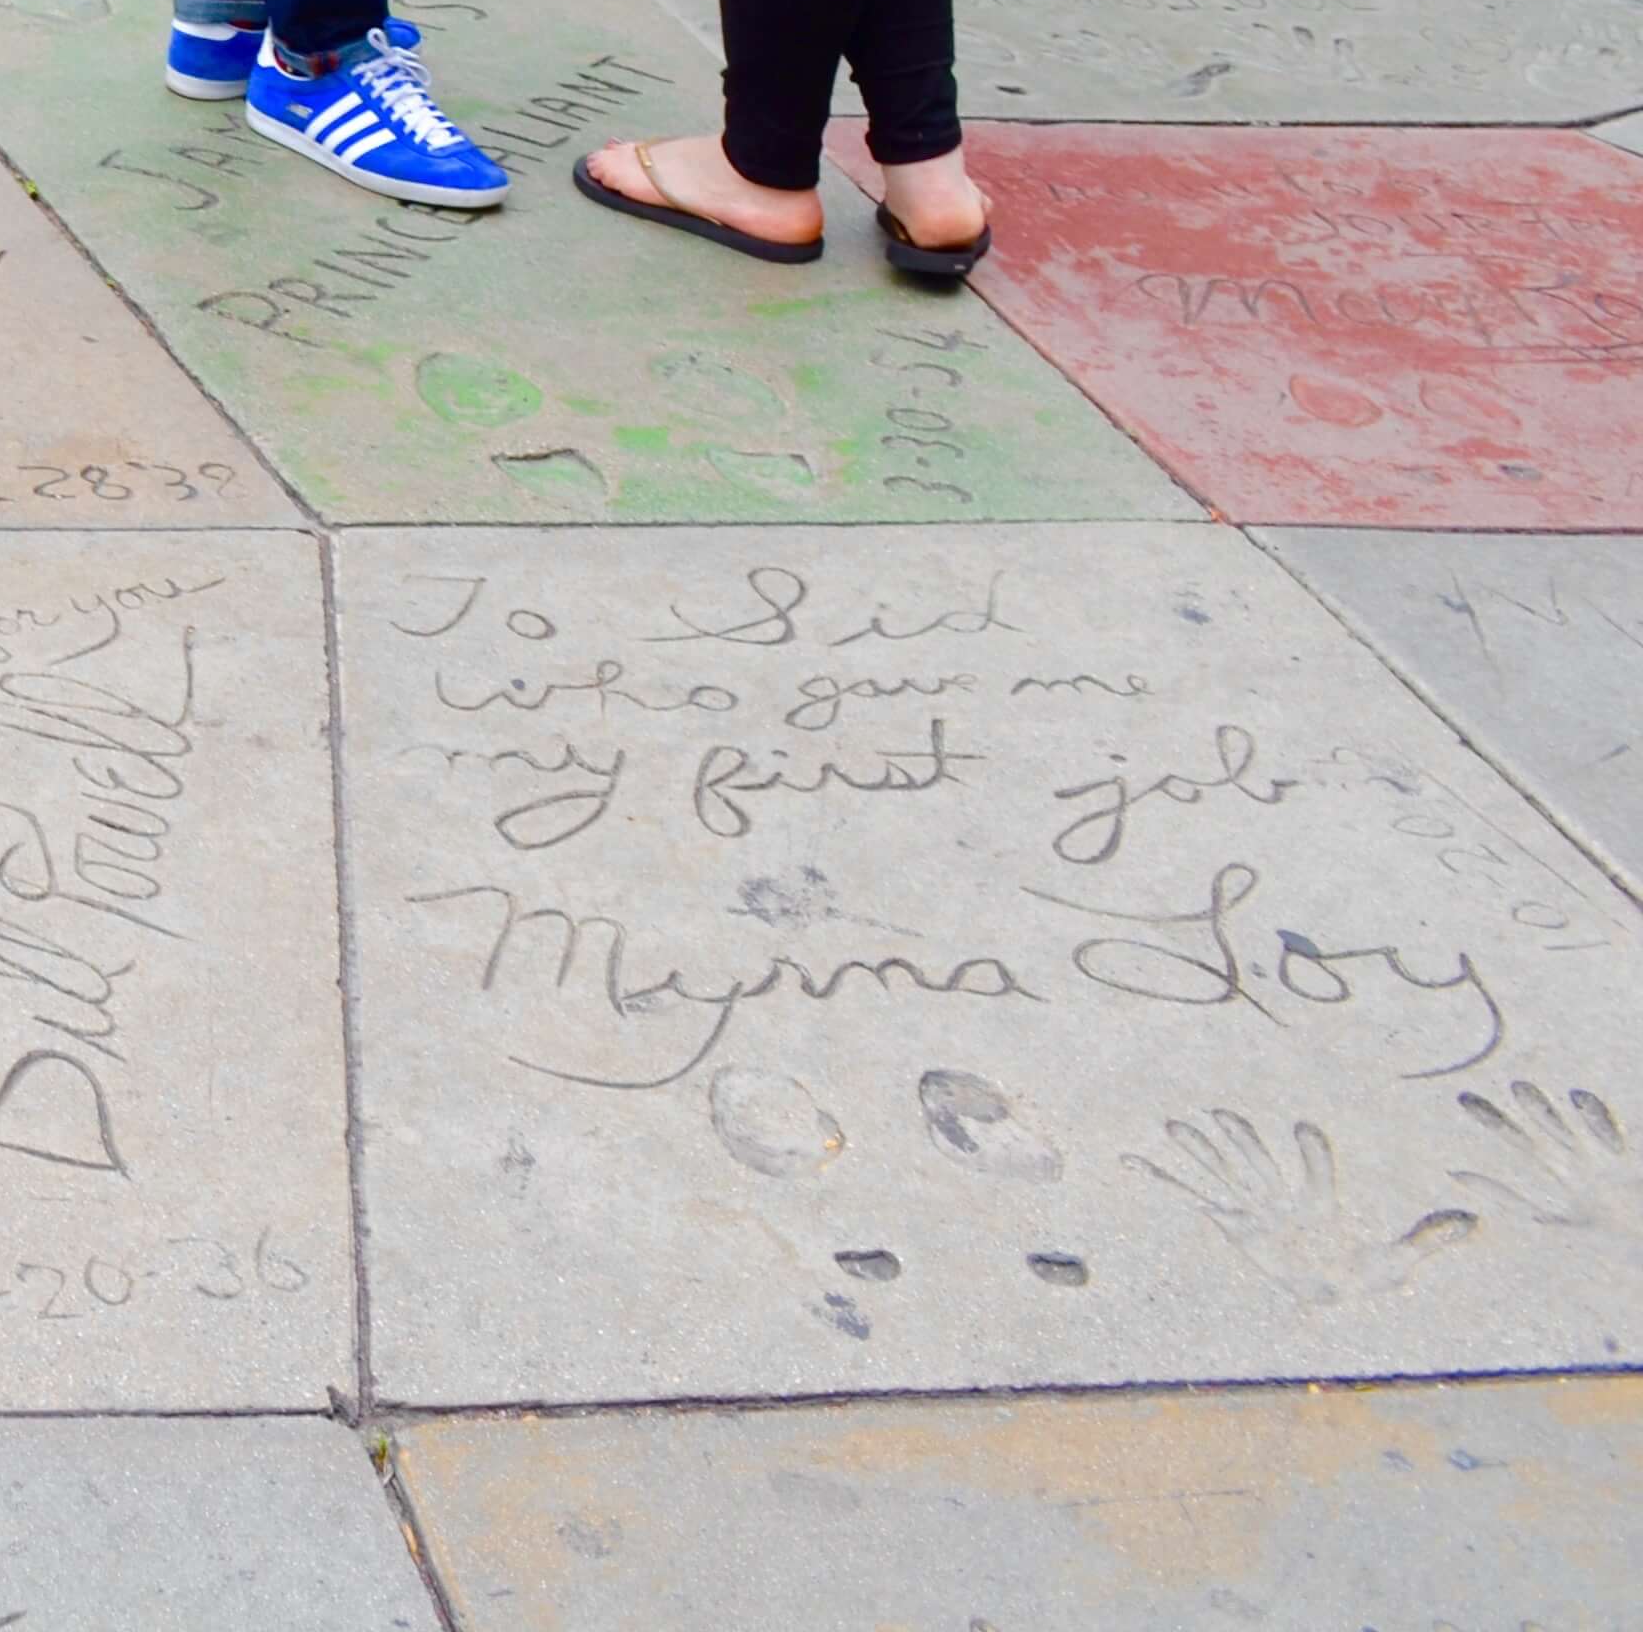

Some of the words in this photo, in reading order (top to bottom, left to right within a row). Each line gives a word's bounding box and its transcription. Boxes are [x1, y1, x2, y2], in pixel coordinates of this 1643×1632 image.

[635, 566, 1030, 650] Sid
[693, 718, 985, 838] first
[1015, 860, 1510, 1083] Loy
